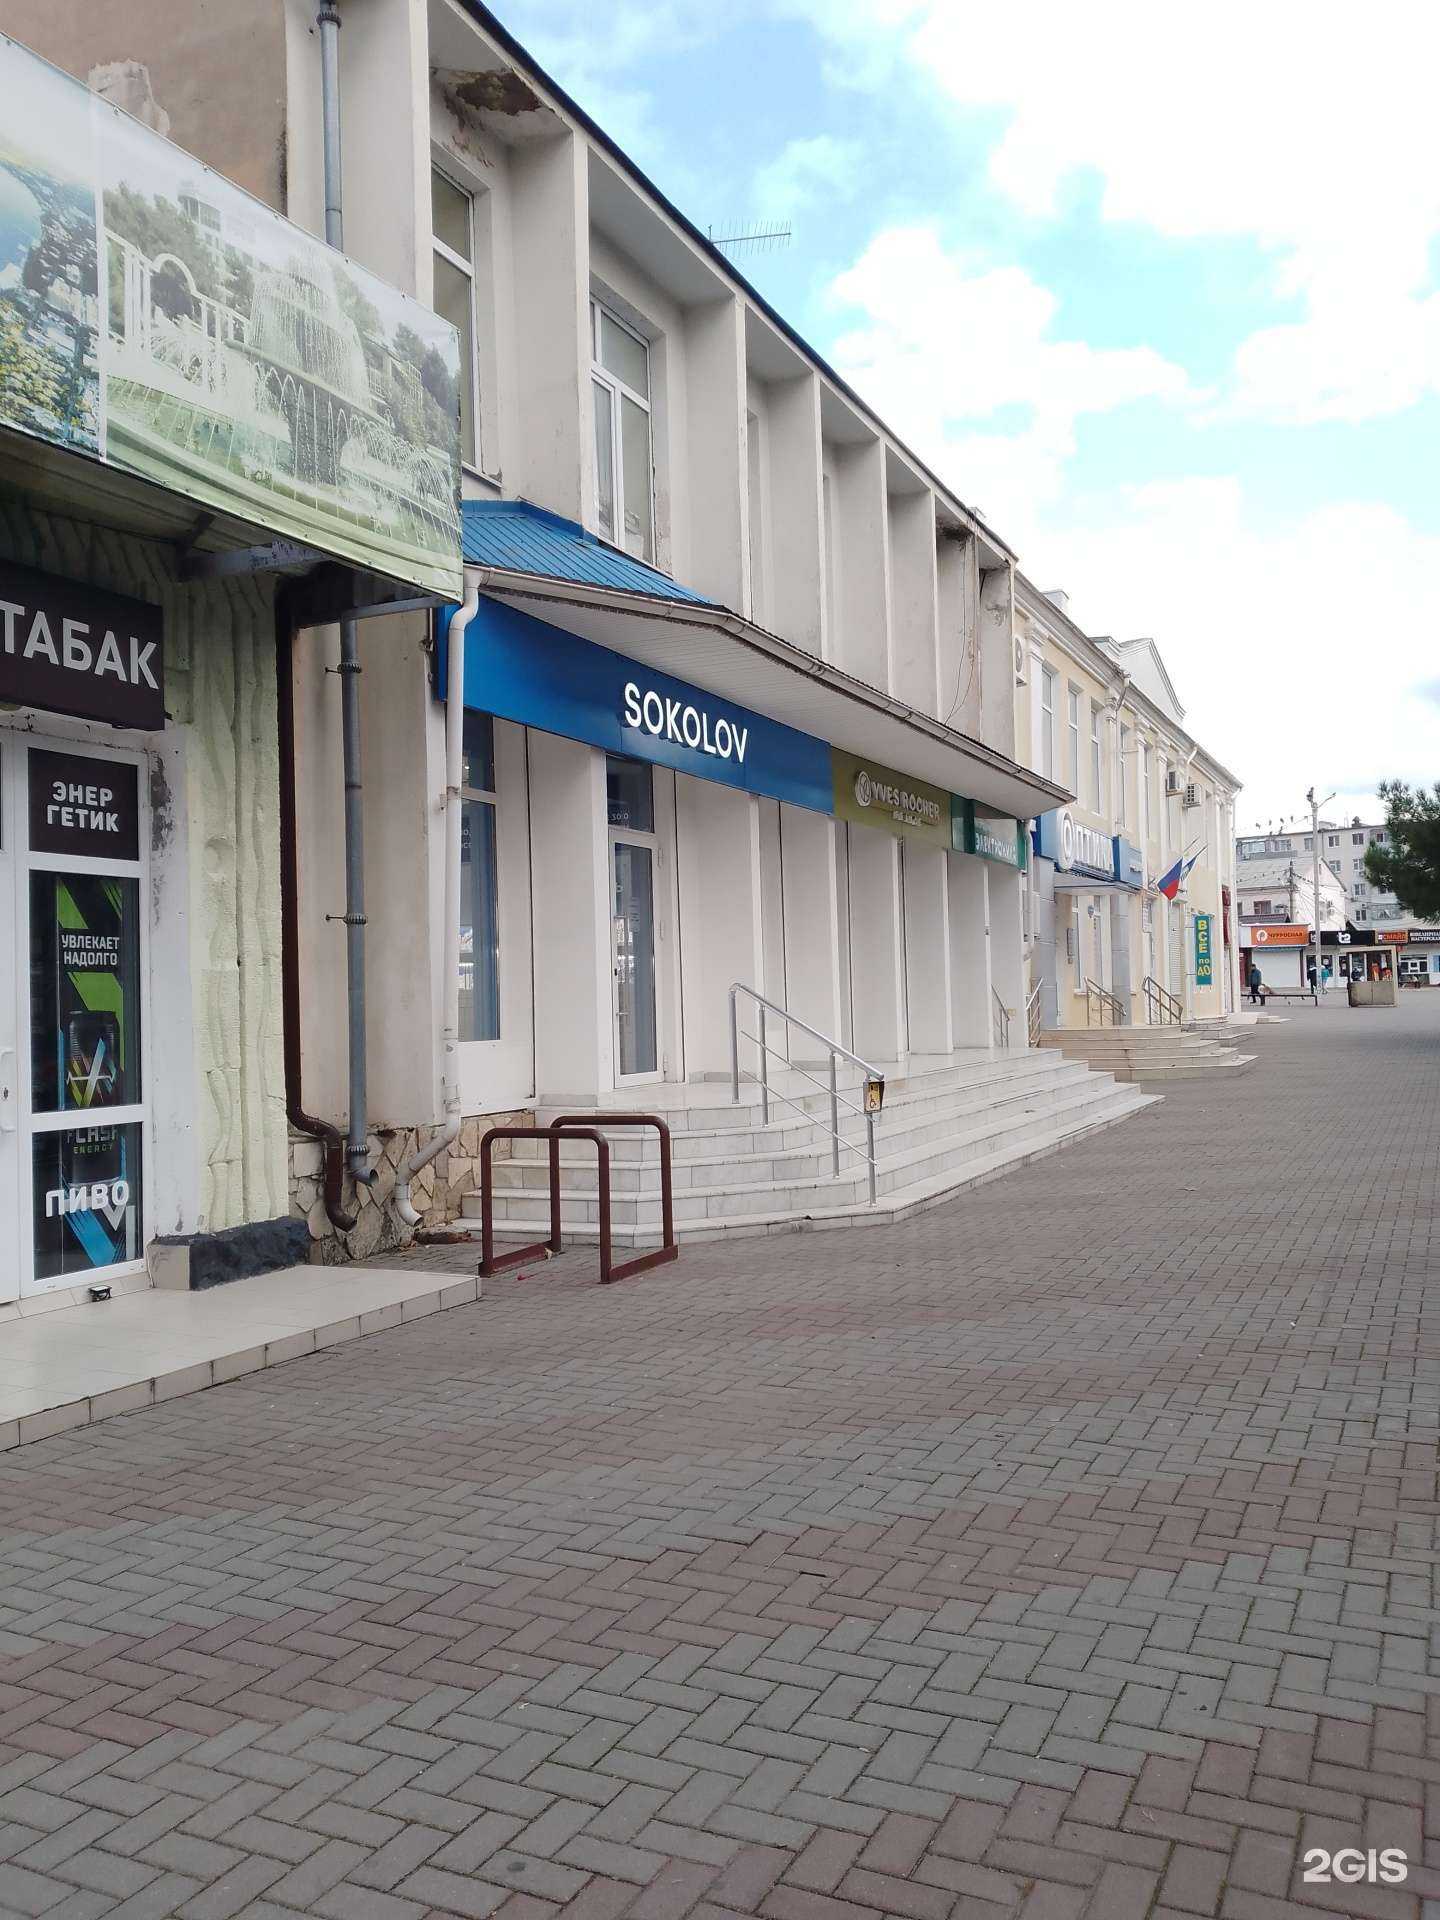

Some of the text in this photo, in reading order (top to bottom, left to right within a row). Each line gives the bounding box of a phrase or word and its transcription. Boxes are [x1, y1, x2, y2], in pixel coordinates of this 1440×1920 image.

[0, 600, 159, 689] ТАБАК
[624, 682, 748, 763] SOKOLOV
[52, 781, 113, 807] ЭНЕР
[47, 804, 120, 832] ГЕТИК
[61, 934, 120, 950] УВЛЕКАЕТ
[1198, 920, 1208, 953] ВСЕ
[63, 951, 118, 967] НАДОЛГО
[45, 1180, 130, 1218] ПИВО
